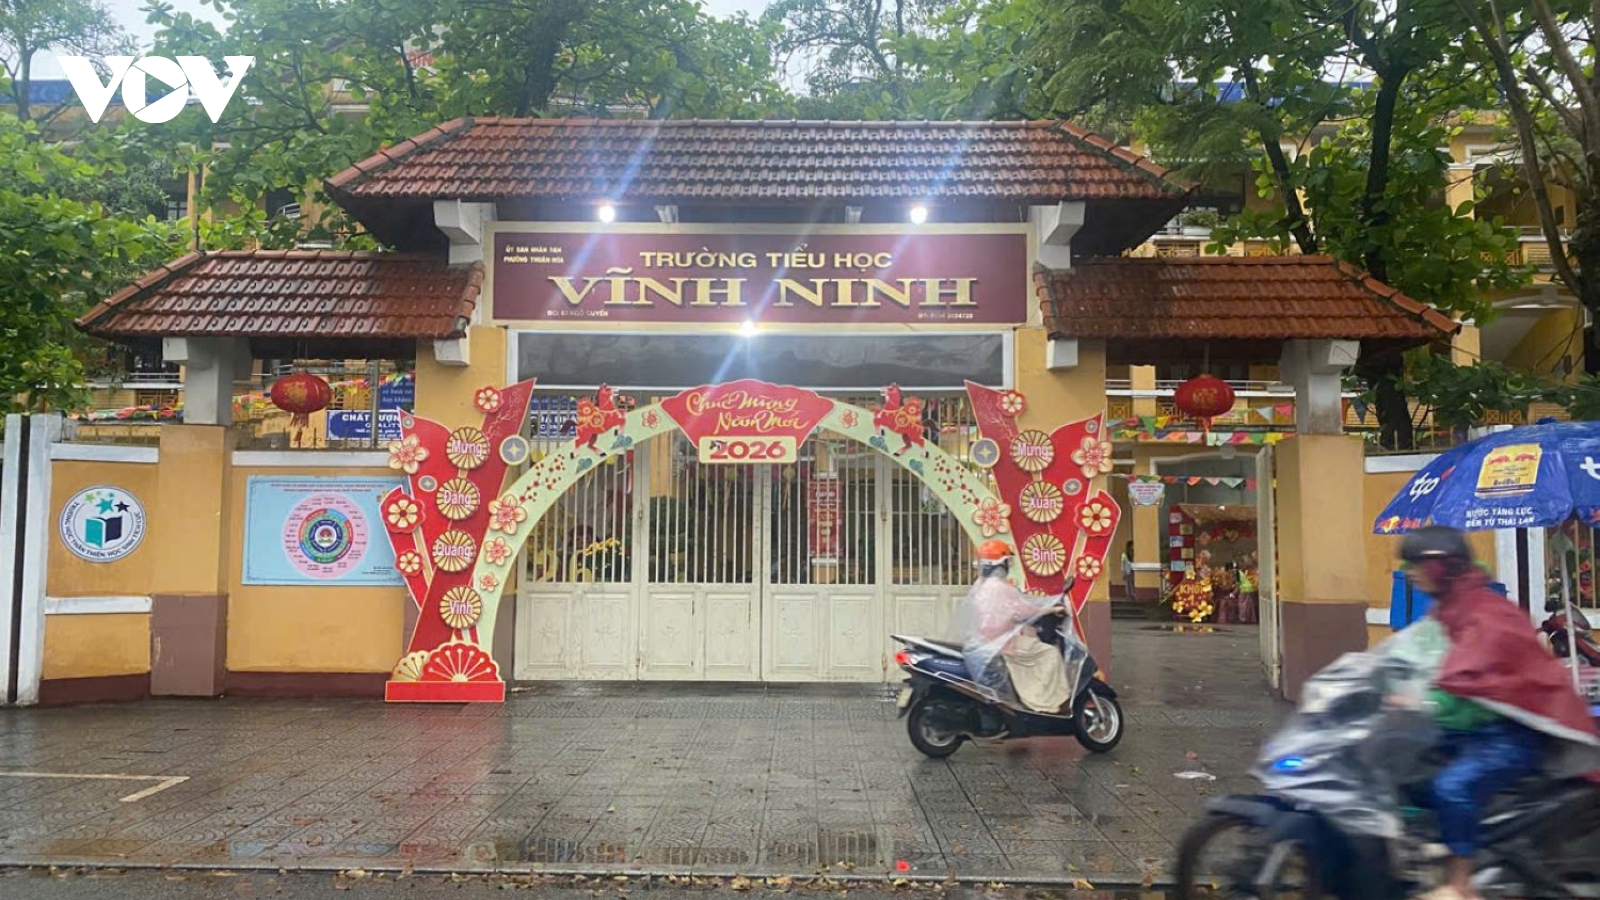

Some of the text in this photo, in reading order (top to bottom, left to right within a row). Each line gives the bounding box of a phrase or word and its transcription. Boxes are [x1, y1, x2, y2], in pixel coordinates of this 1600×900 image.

[639, 243, 893, 272] TRƯỜNG TIỂU HỌC
[547, 267, 978, 307] VĨNH NINH
[709, 440, 787, 460] 2026
[436, 540, 472, 561] Quang
